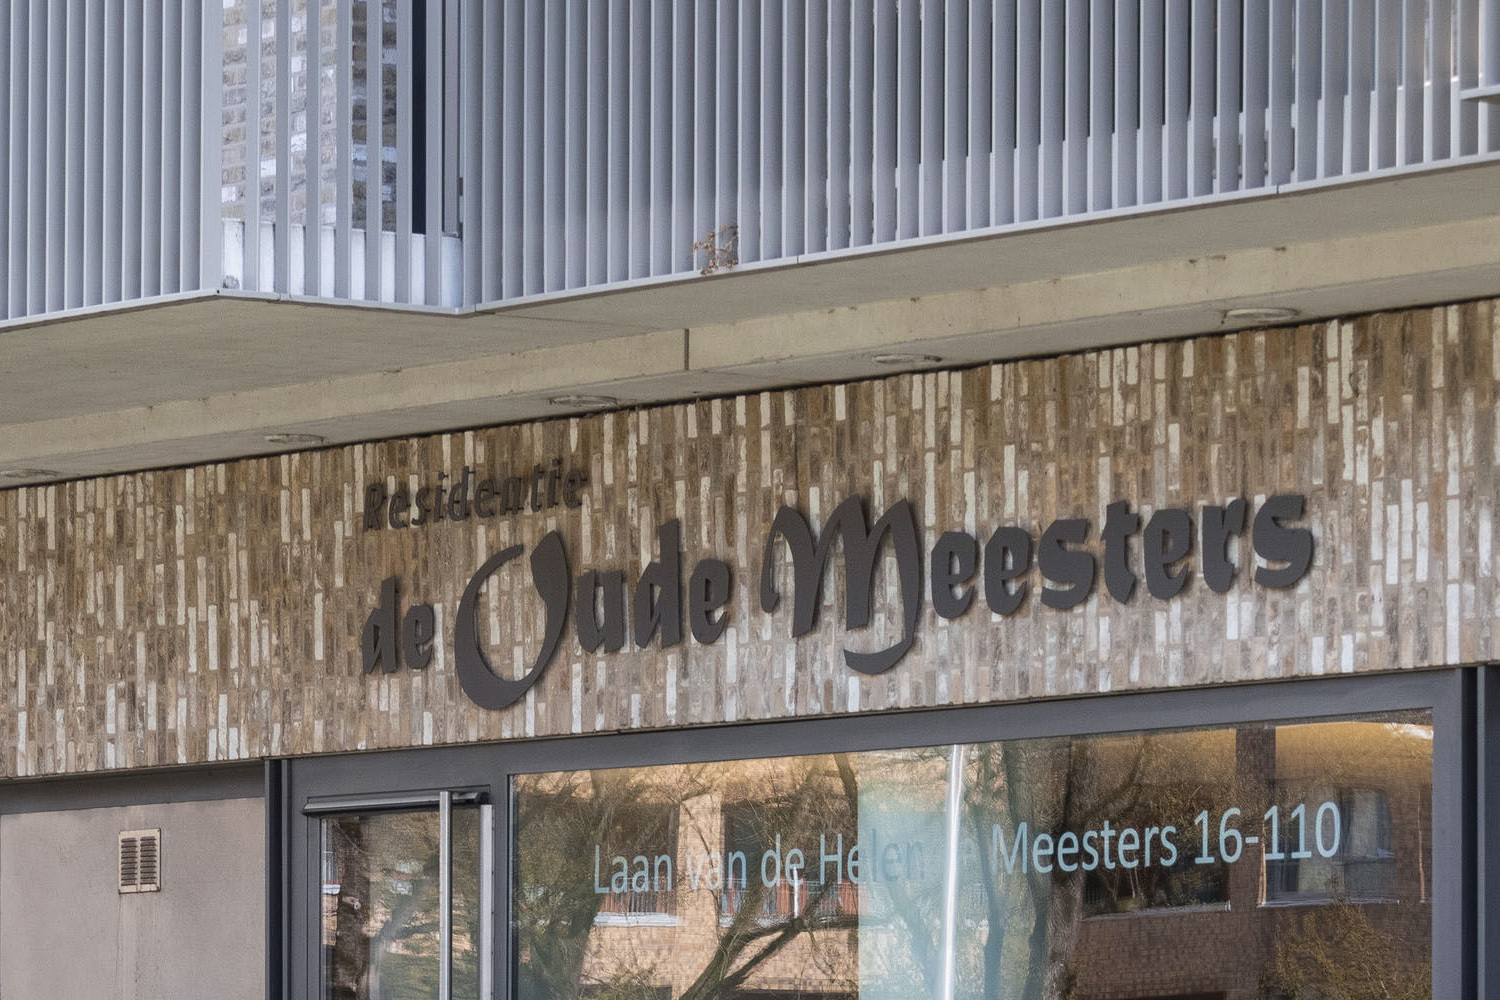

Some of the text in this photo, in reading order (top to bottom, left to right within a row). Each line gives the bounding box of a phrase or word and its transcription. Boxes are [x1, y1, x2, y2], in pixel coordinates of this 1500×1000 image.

[364, 457, 584, 532] Residentie
[362, 494, 1313, 711] de Oude Meesters
[594, 844, 672, 894] Laan
[686, 850, 747, 891] van
[761, 833, 805, 888] de
[991, 821, 1179, 876] Meesters
[1193, 801, 1341, 865] 16-110
